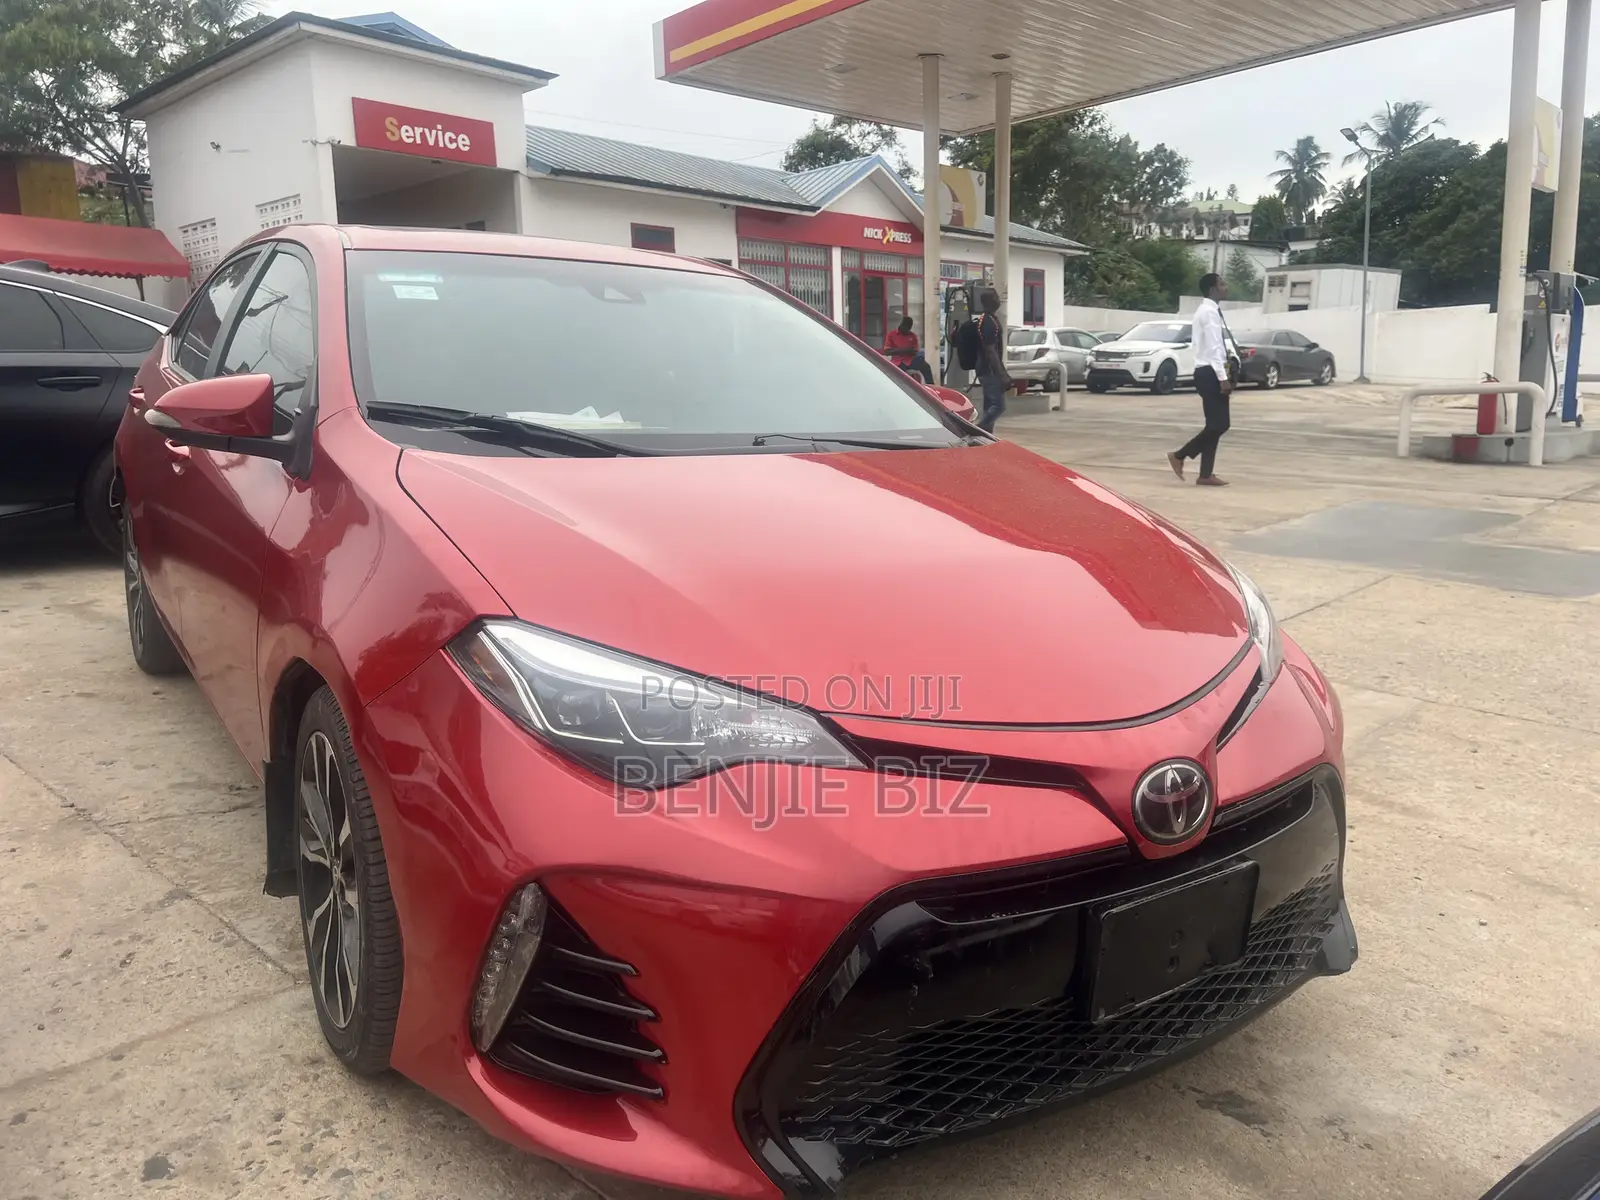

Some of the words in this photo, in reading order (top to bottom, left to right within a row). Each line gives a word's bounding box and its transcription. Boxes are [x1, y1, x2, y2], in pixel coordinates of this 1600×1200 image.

[385, 116, 471, 152] Service
[863, 227, 883, 240] NICK
[882, 226, 912, 244] XPRESS
